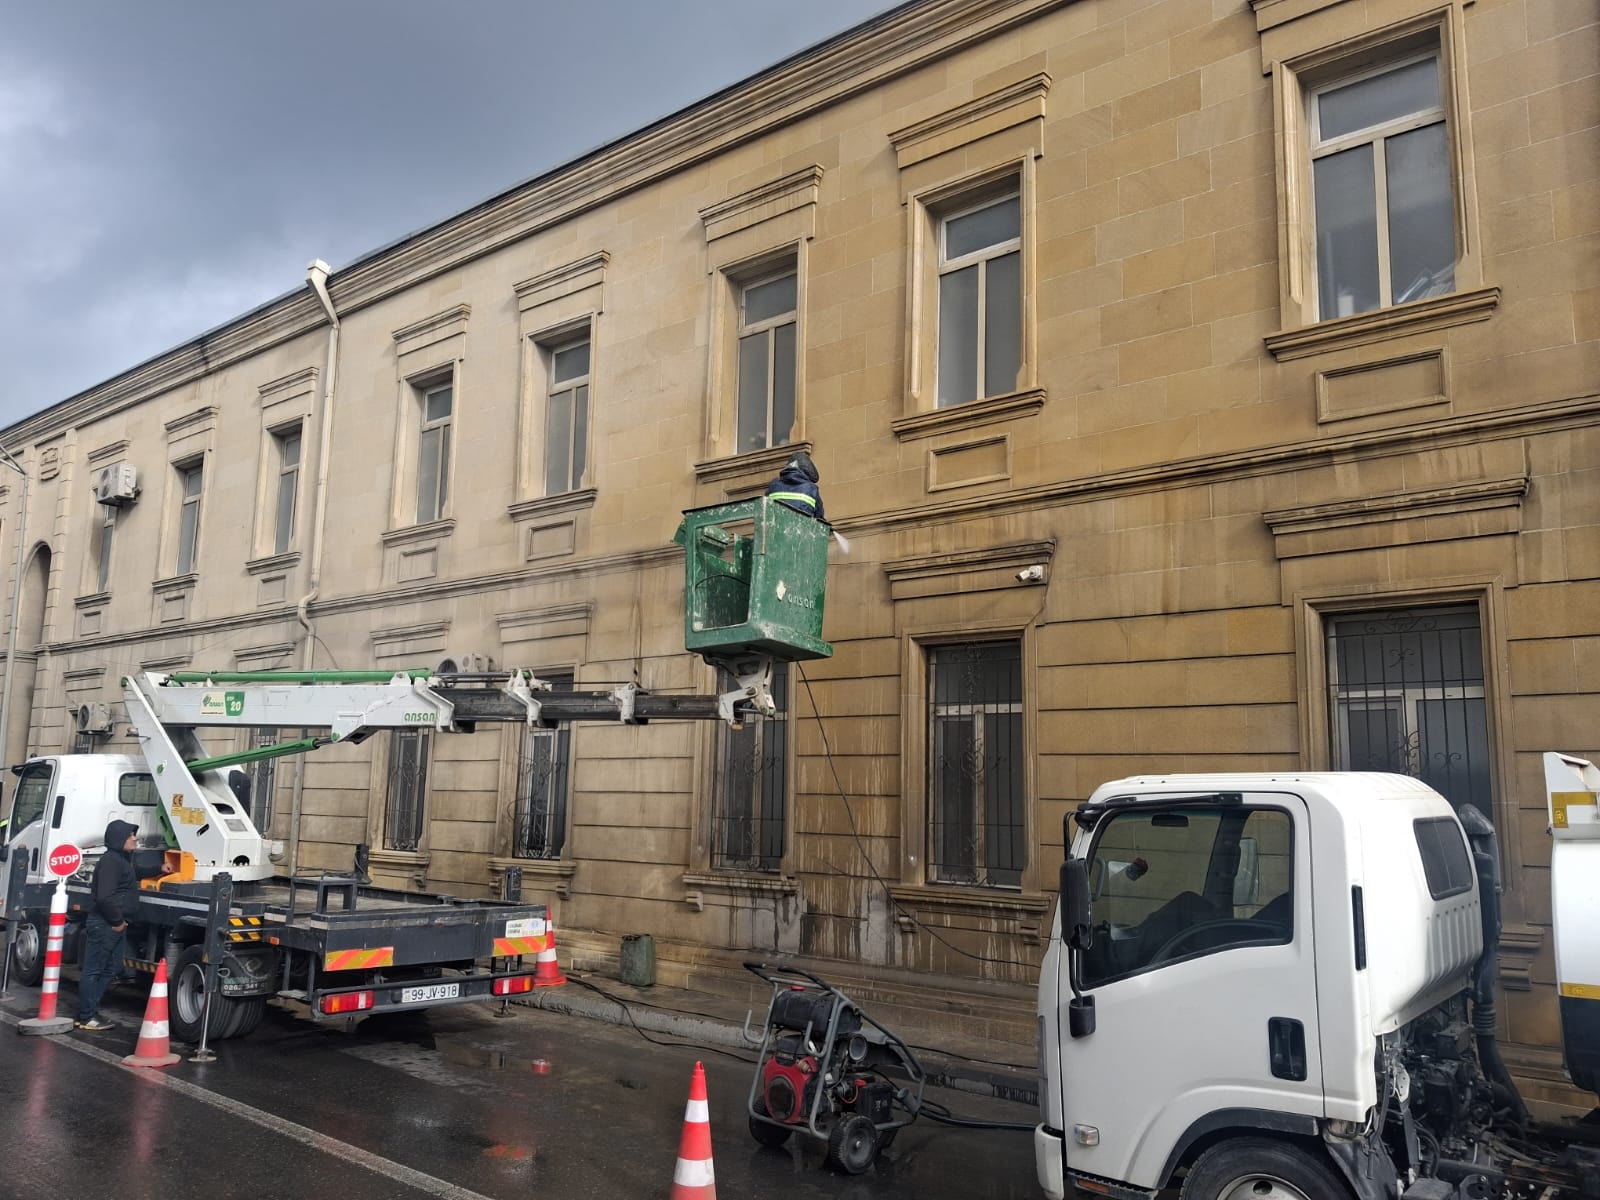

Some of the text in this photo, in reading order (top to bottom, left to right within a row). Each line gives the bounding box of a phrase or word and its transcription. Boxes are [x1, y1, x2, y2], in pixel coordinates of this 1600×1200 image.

[230, 701, 242, 712] 20
[404, 712, 435, 721] ansan
[50, 854, 79, 866] STOP
[411, 985, 457, 1001] 99-JV-918
